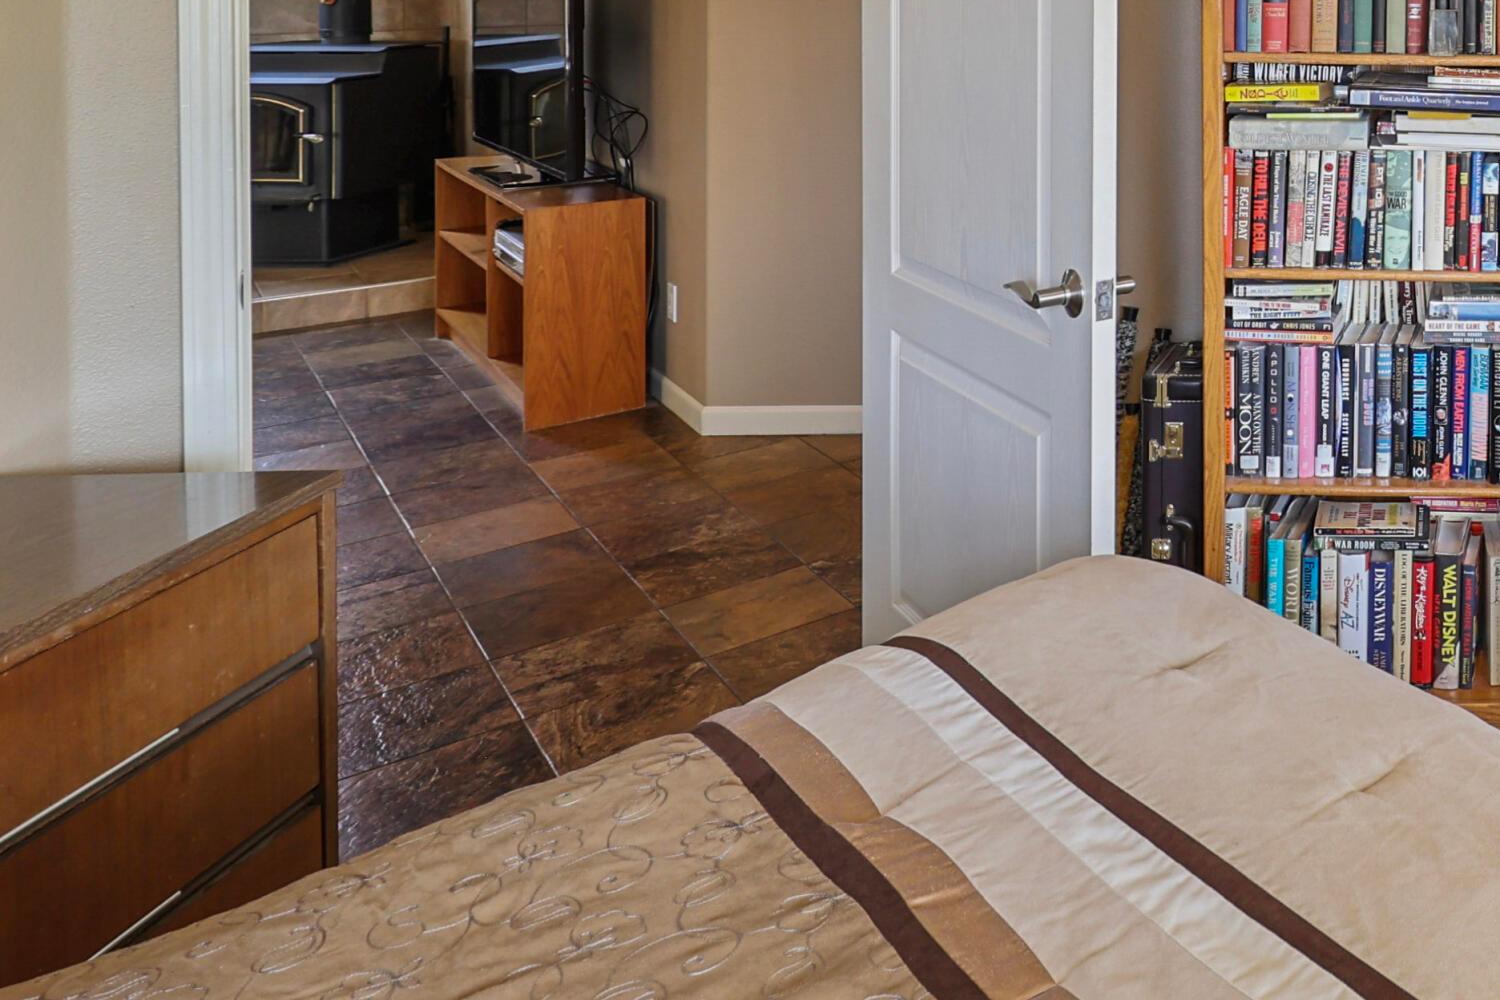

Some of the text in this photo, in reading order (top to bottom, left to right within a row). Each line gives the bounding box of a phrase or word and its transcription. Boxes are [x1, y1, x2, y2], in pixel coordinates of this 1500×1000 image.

[1239, 187, 1248, 240] EAGLE DAY
[1252, 159, 1266, 252] TO KILL THE DEVIL
[1305, 172, 1317, 241] CLOSING THE CIRCLE
[1320, 174, 1333, 236] THE LAST KAMIKAZE
[1335, 156, 1349, 255] THE DEVIL'S ANVIL
[1385, 198, 1407, 210] WAR
[1322, 351, 1330, 419] ONE GIANT LEAP
[1413, 353, 1426, 437] FIRST ON THE MOON
[1454, 350, 1464, 432] MEN FROM EARTH
[1240, 393, 1251, 455] MOON
[1253, 422, 1260, 435] ON
[1334, 540, 1375, 550] WAR ROOM
[1304, 561, 1314, 599] Famous
[1442, 564, 1456, 665] WALT DISNEY
